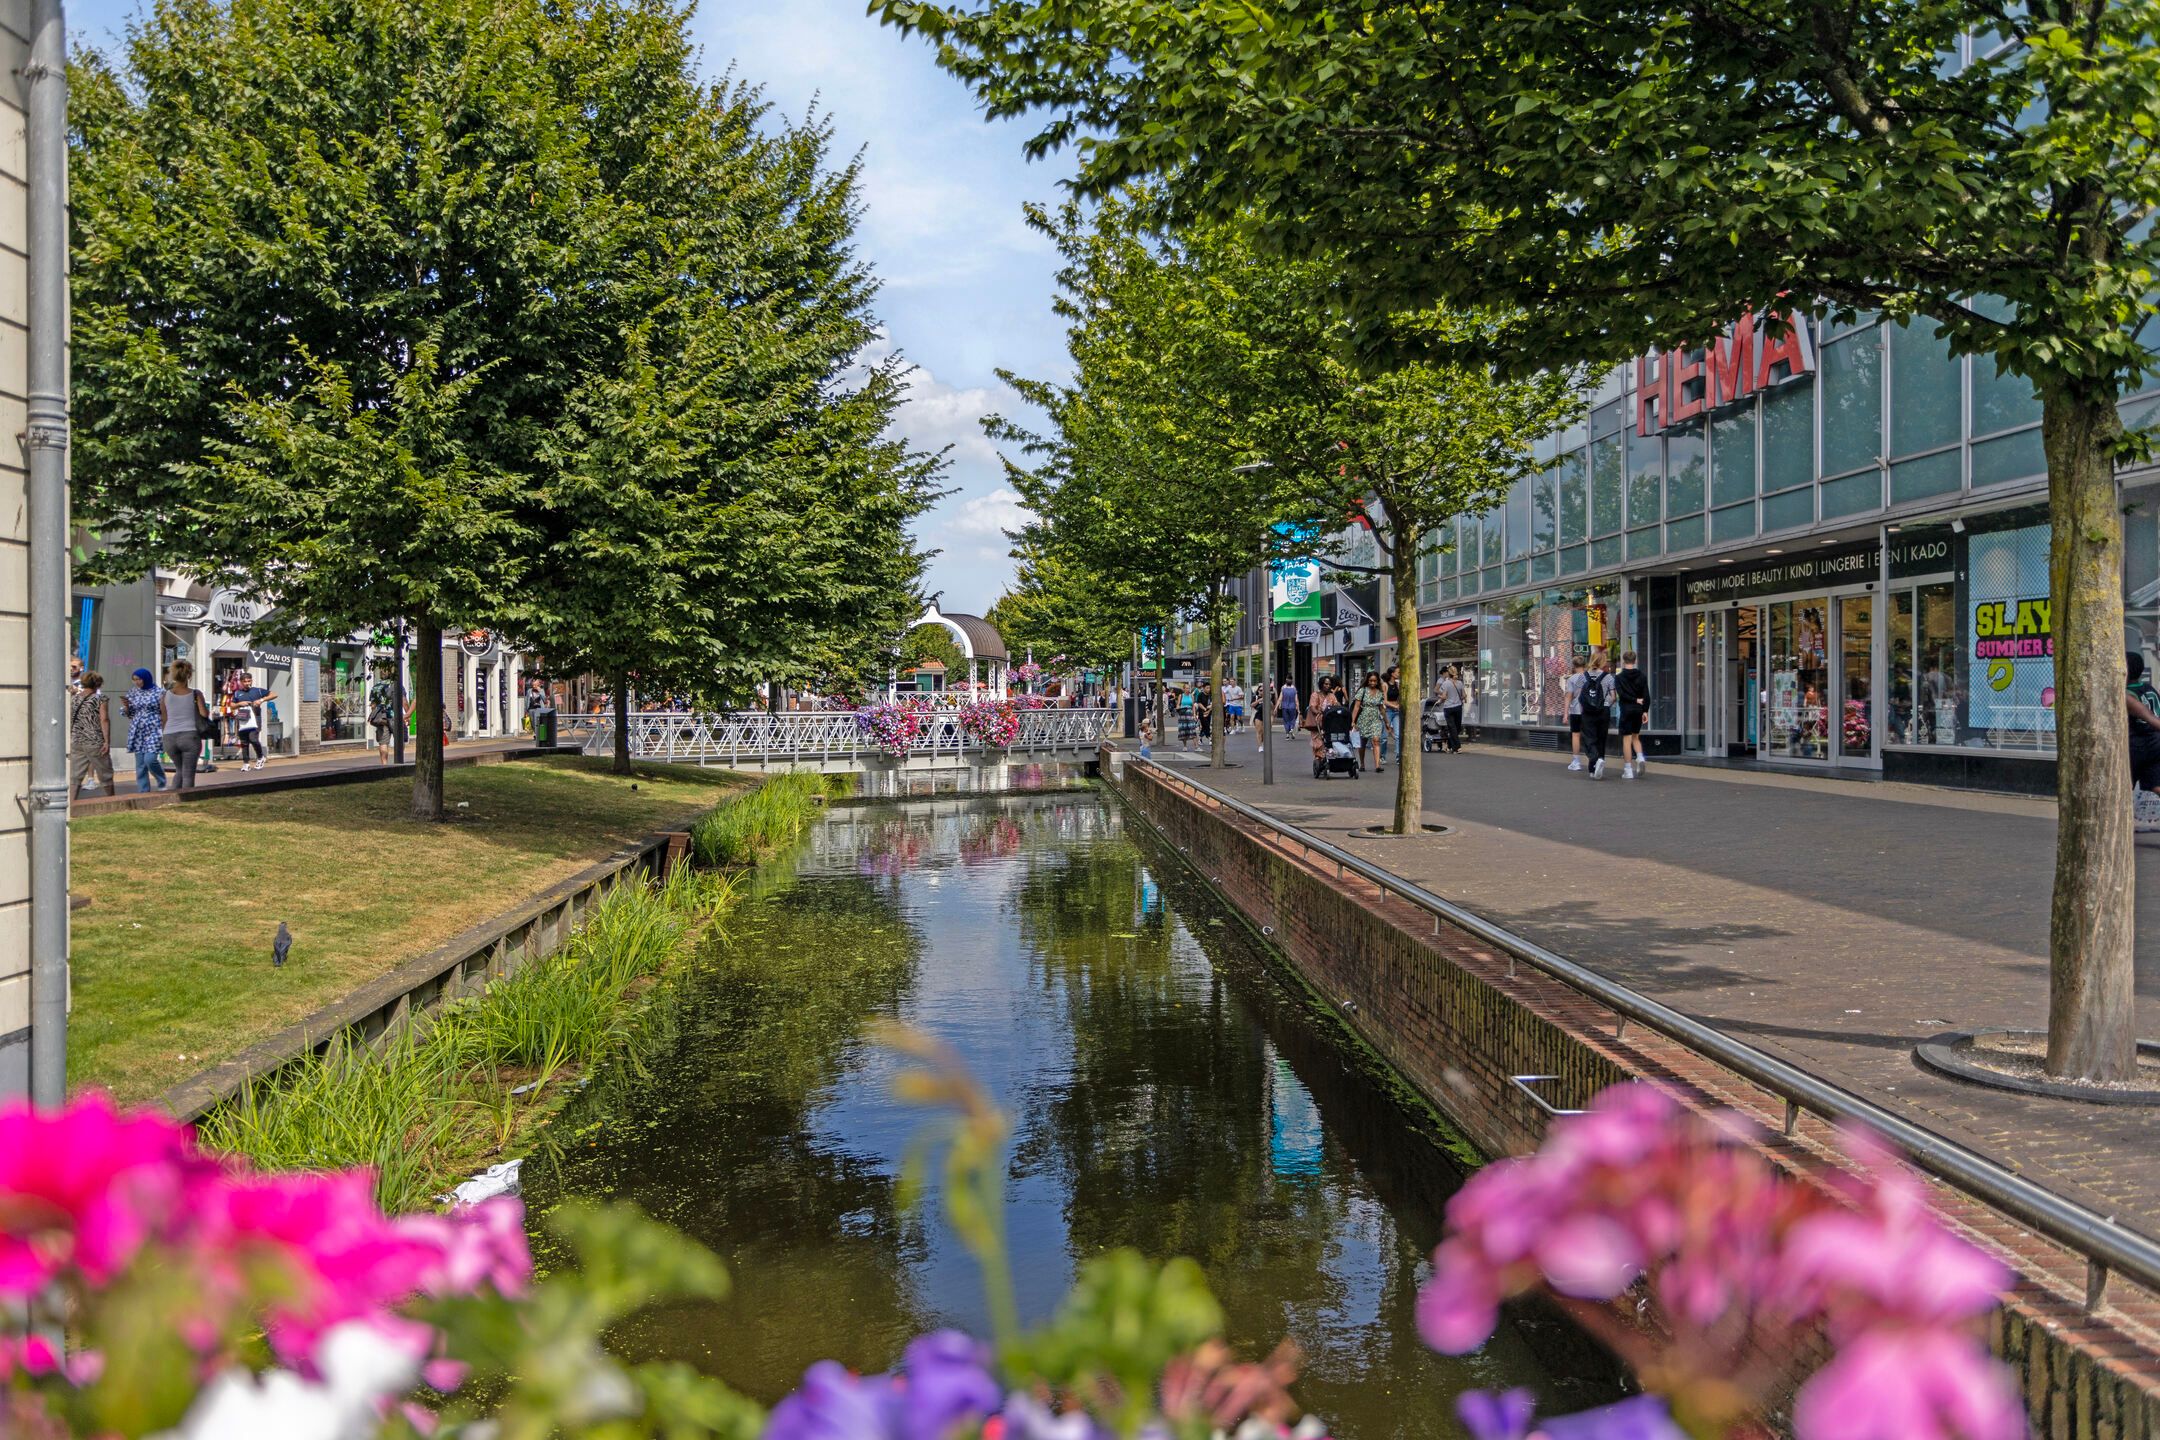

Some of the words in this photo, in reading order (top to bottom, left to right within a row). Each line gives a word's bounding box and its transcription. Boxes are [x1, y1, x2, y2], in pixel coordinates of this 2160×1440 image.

[1637, 292, 1810, 437] HEMA
[1687, 579, 1716, 594] WONEN
[1721, 573, 1745, 589] MODE
[1751, 566, 1782, 585] BEAUTY
[1789, 563, 1813, 579] KIND
[1821, 554, 1865, 575] LINGERIE
[1910, 541, 1947, 561] KADO
[171, 605, 187, 613] VAN
[189, 605, 198, 613] OS
[221, 603, 238, 618] VAN
[240, 605, 251, 620] OS
[1339, 609, 1359, 621] Etos
[1976, 600, 2051, 636] SLAY
[1300, 625, 1319, 636] Etos
[1976, 639, 2043, 658] SUMMER
[264, 653, 280, 662] VAN
[281, 655, 291, 663] OS
